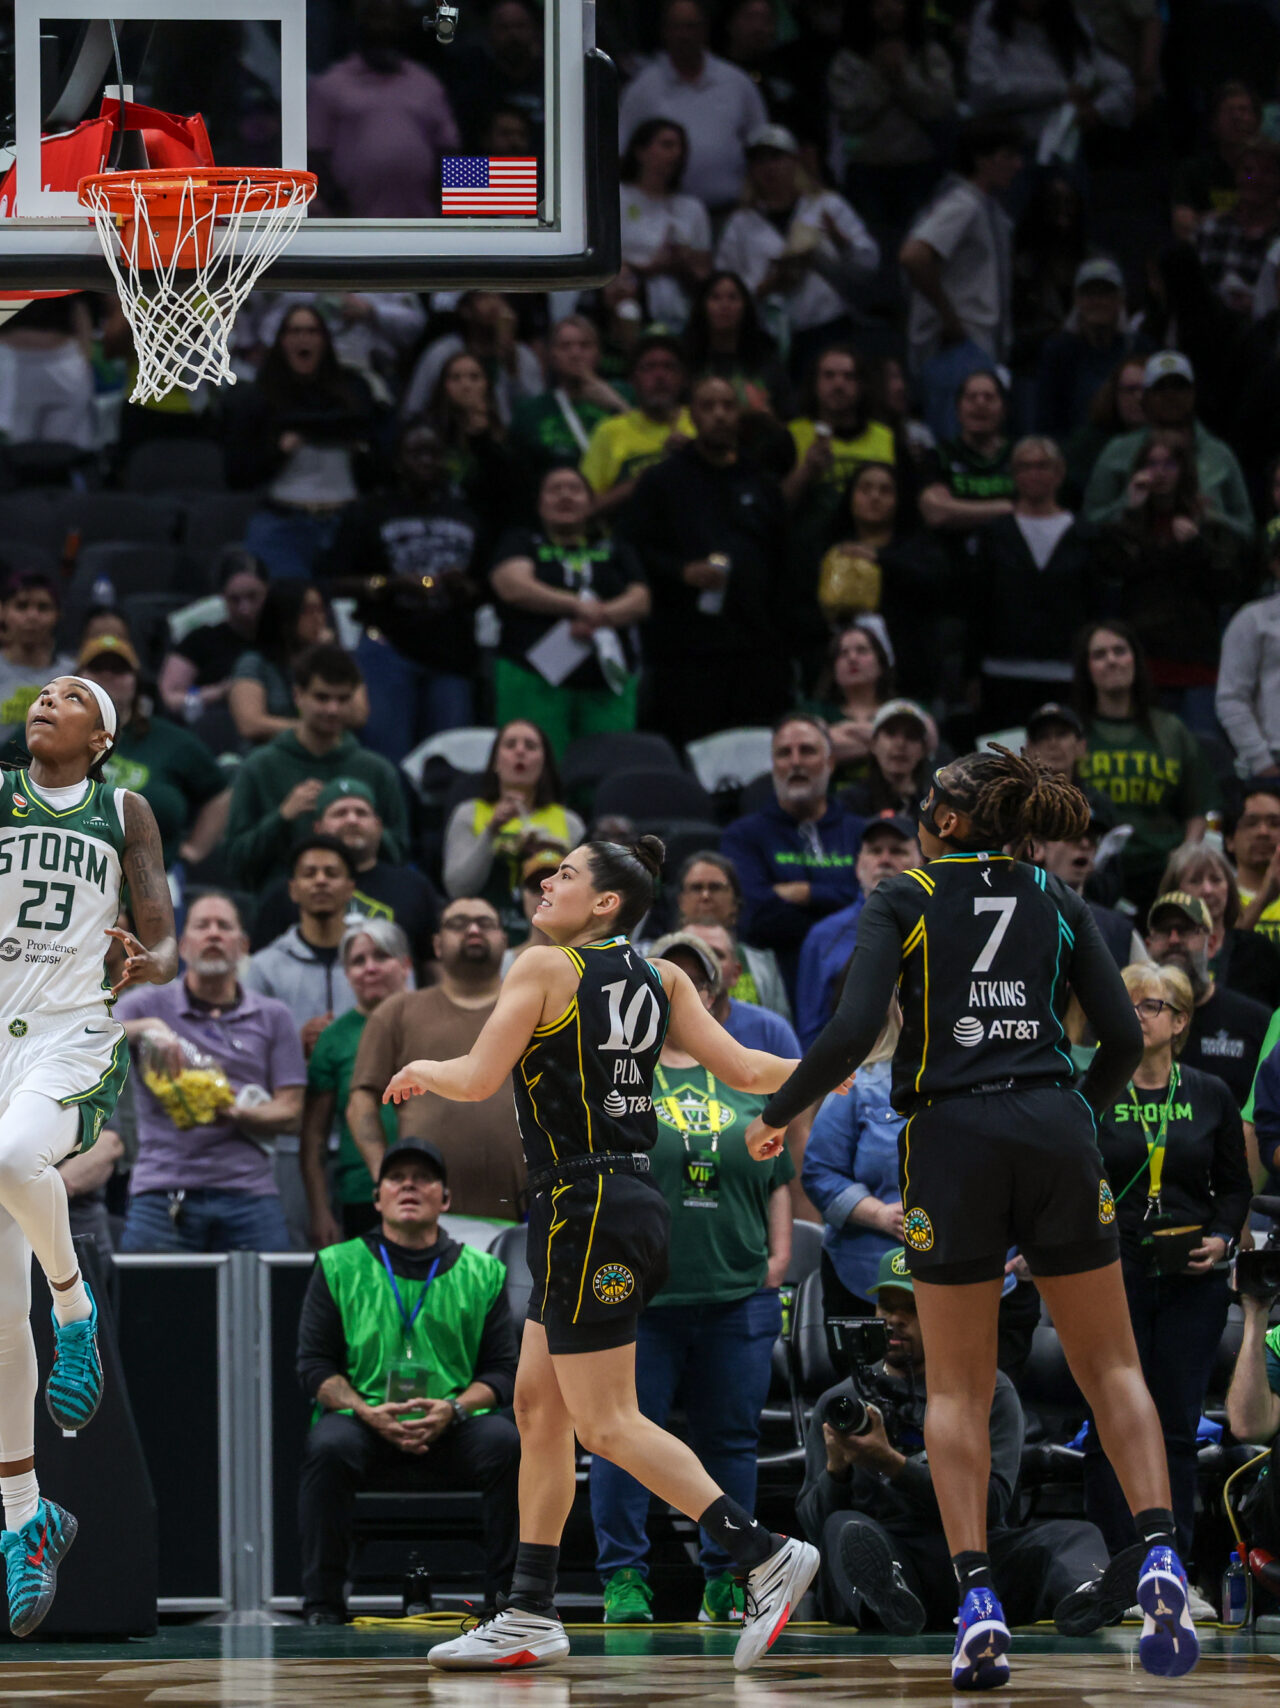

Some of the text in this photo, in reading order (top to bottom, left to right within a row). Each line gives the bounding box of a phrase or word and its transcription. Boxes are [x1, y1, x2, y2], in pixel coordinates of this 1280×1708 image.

[17, 879, 76, 932] 23
[971, 896, 1017, 973] 7
[26, 938, 78, 956] Providence
[24, 953, 61, 965] SWEDISH
[968, 980, 1027, 1008] ATKINS
[597, 979, 661, 1054] 10
[987, 1019, 1041, 1040] AT&T
[1114, 1102, 1193, 1123] STORM
[688, 1165, 716, 1182] VIP
